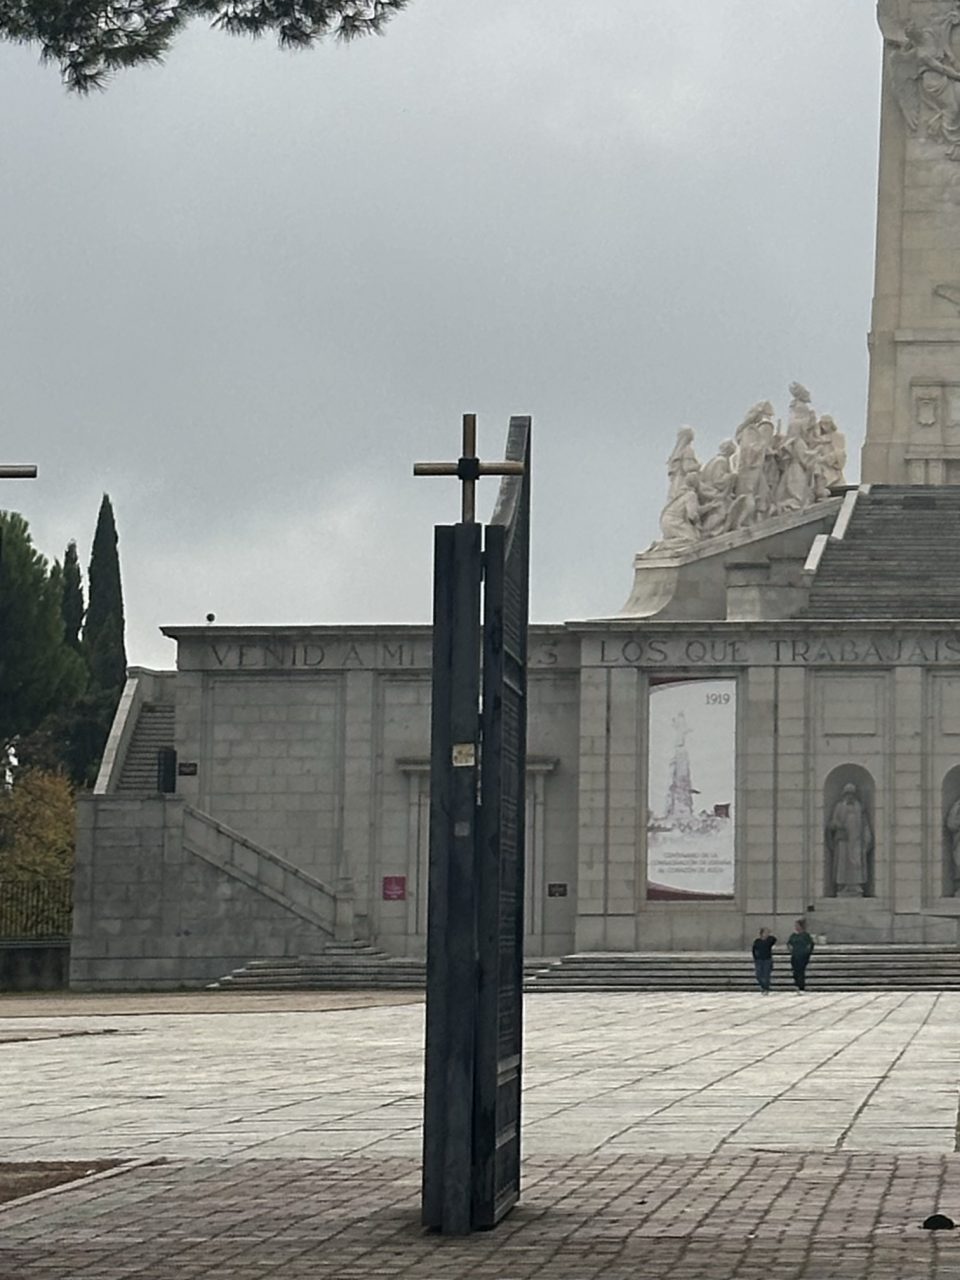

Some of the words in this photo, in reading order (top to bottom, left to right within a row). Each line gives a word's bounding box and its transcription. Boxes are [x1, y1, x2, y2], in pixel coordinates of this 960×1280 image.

[210, 644, 326, 667] VENID
[341, 643, 364, 667] A
[381, 644, 416, 667] MI
[600, 639, 669, 663] LOS
[685, 639, 749, 663] QUE
[705, 692, 731, 705] 1919
